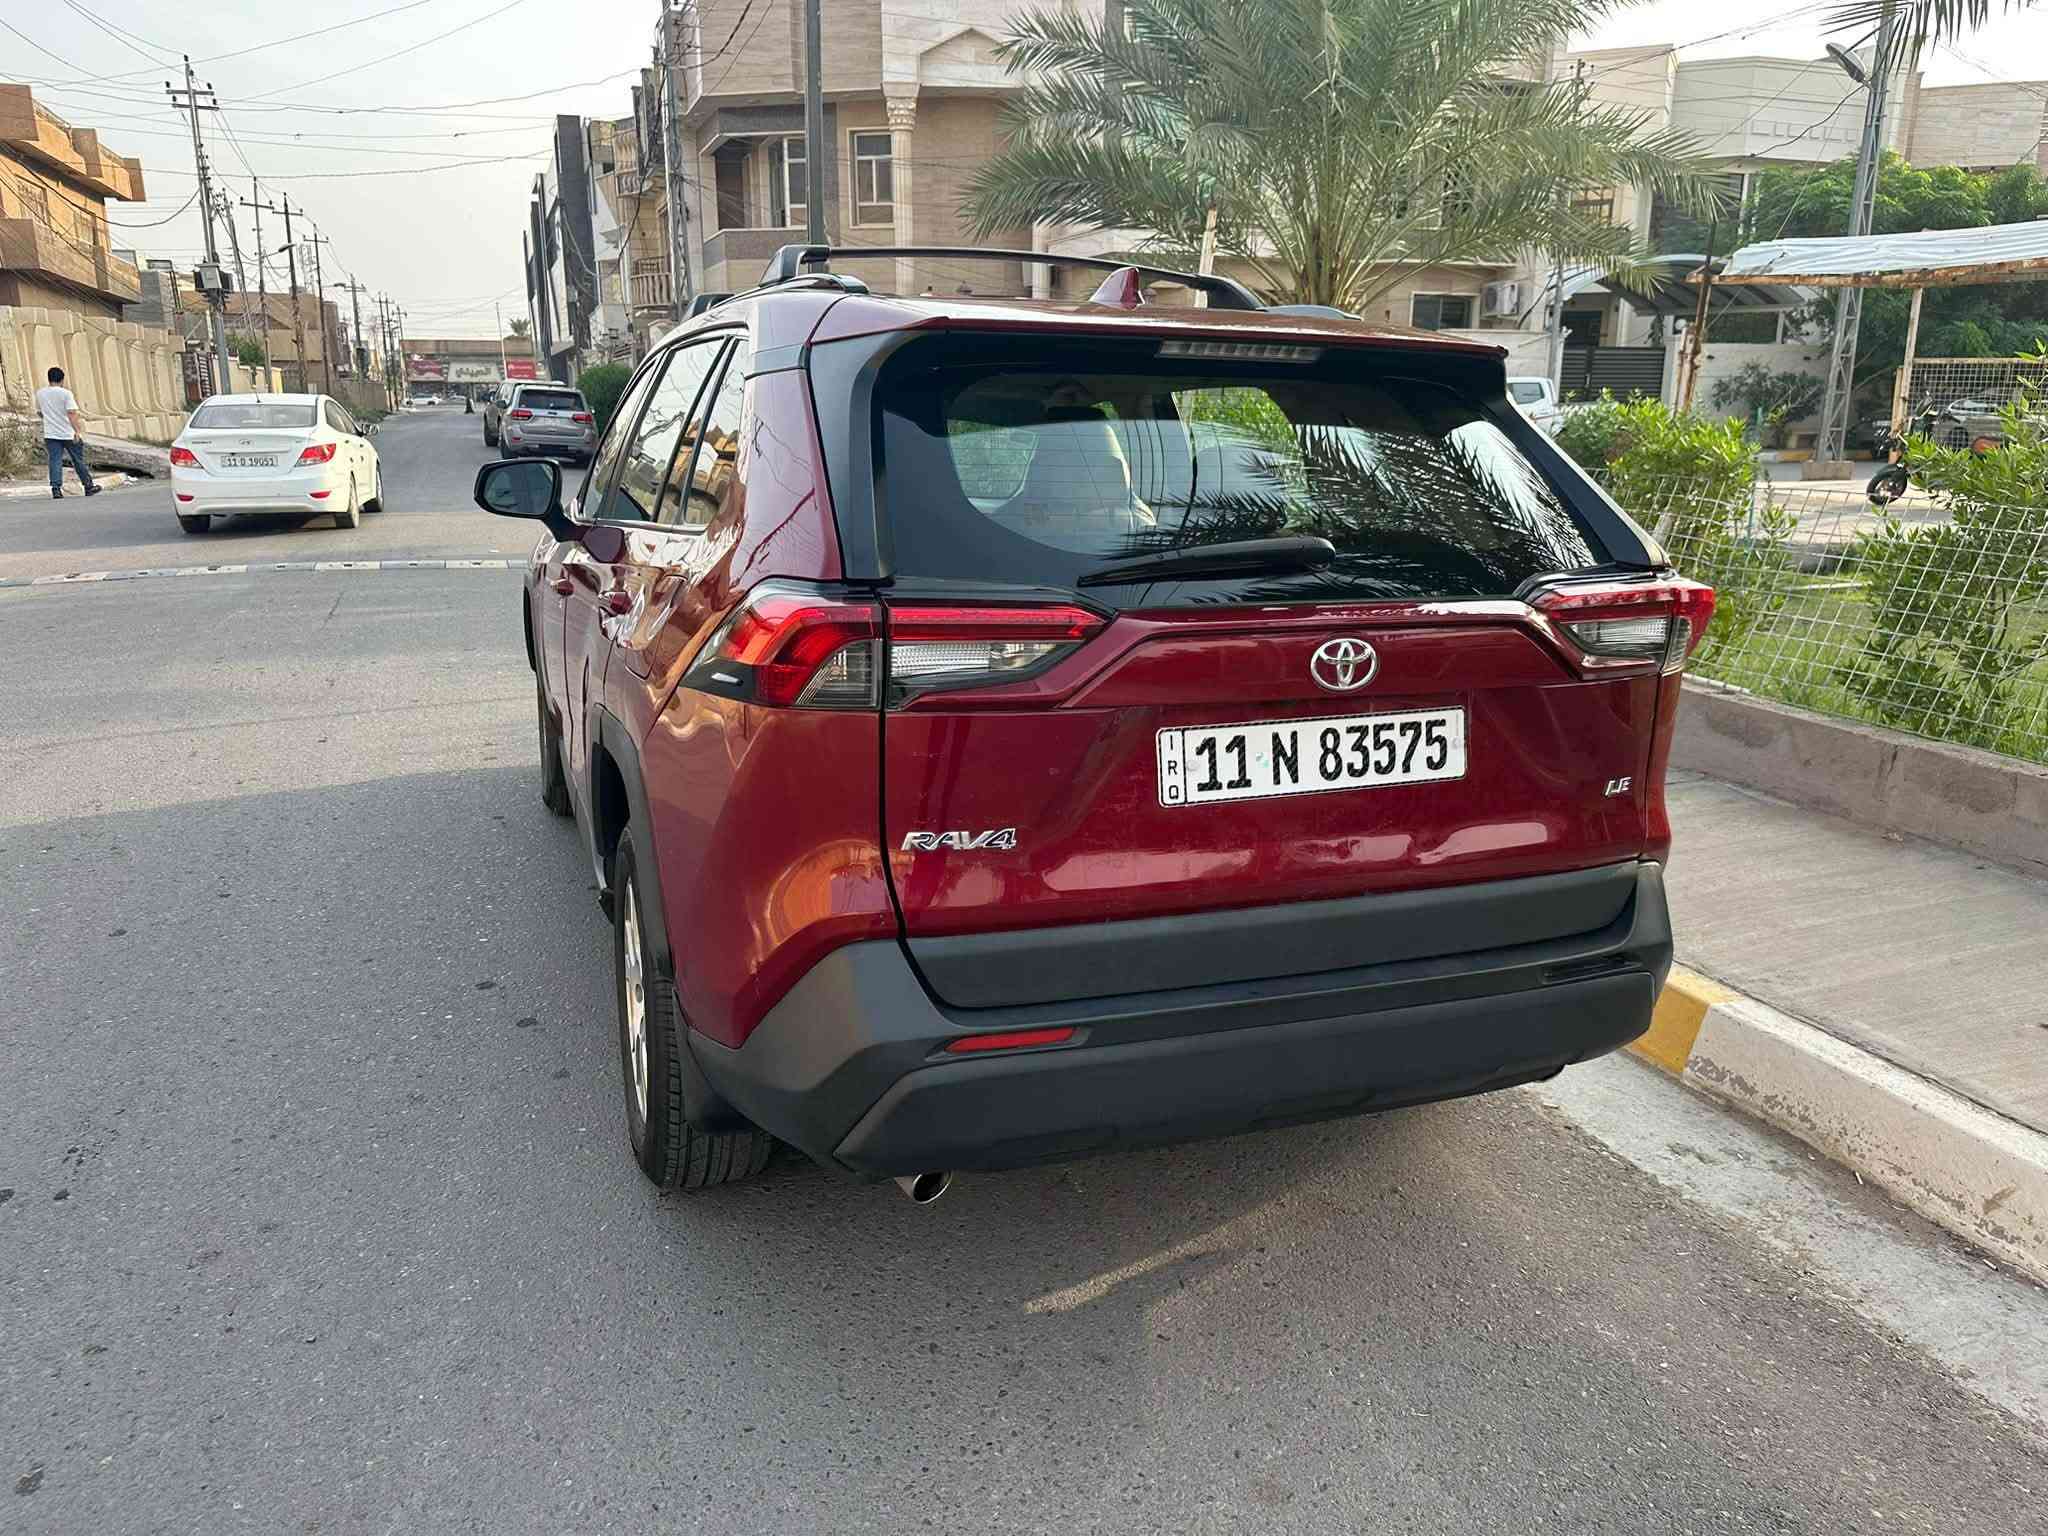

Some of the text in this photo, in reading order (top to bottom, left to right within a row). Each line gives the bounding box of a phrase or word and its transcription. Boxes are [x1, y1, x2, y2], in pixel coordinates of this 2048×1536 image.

[1195, 718, 1448, 792] 11 N 83575
[1604, 776, 1632, 797] LE
[901, 828, 1017, 851] RAV4
